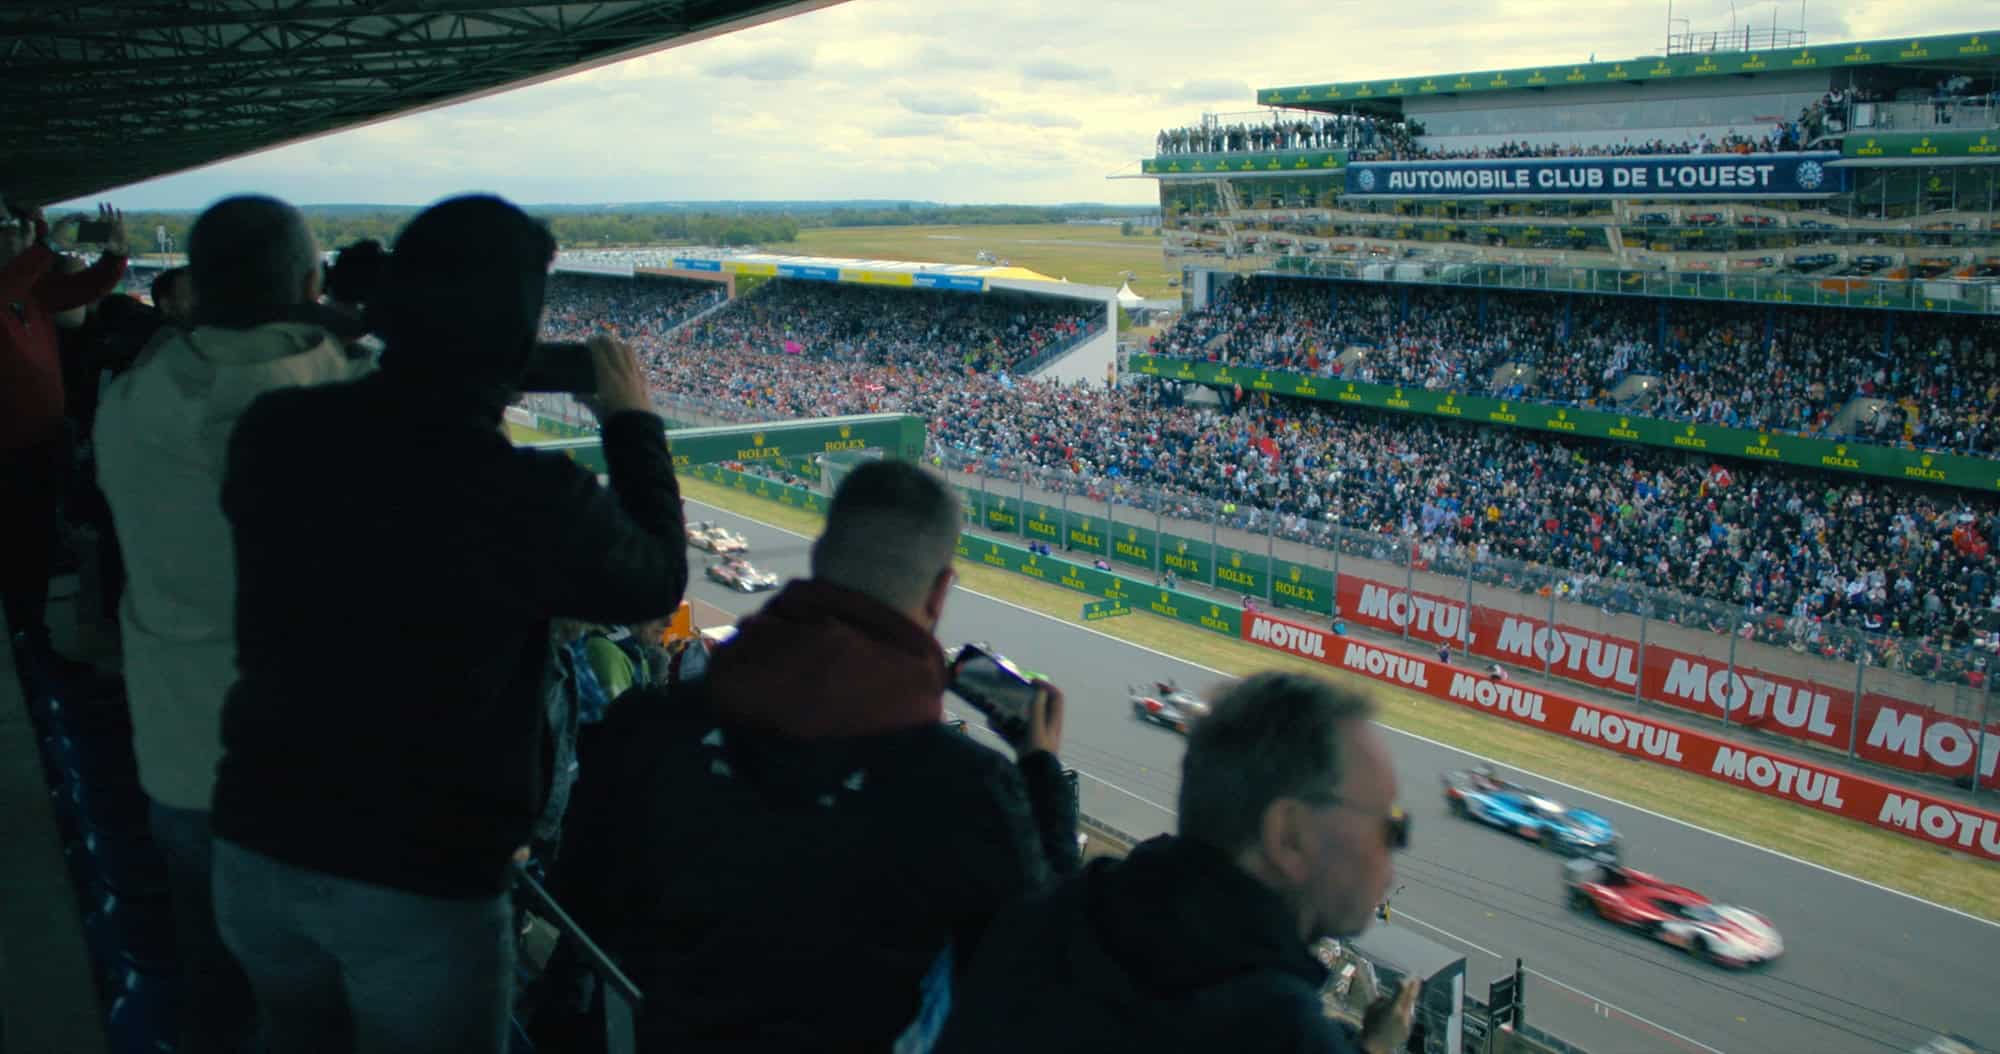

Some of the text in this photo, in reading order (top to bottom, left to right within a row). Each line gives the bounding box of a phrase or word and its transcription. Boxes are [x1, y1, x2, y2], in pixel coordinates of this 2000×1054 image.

[1388, 164, 1775, 190] AUTOMOBILE CLUB DE L'OUEST
[1608, 427, 1639, 439] ROLEX
[1674, 436, 1707, 448] ROLEX
[737, 447, 781, 460] ROLEX
[825, 439, 865, 450] ROLEX
[1745, 445, 1780, 458] ROLEX
[1822, 455, 1860, 469] ROLEX
[1905, 465, 1946, 480] ROLEX
[1116, 541, 1147, 560] ROLEX
[1217, 567, 1255, 587] ROLEX
[1275, 580, 1314, 602] ROLEX
[1357, 583, 1477, 645] MOTUL
[1250, 617, 1326, 658] MOTUL
[1496, 617, 1639, 686] MOTUL
[1343, 642, 1429, 689] MOTUL
[1449, 672, 1547, 722] MOTUL
[1663, 657, 1836, 738] MOTUL
[1570, 706, 1683, 762] MOTUL
[1711, 746, 1844, 809] MOTUL
